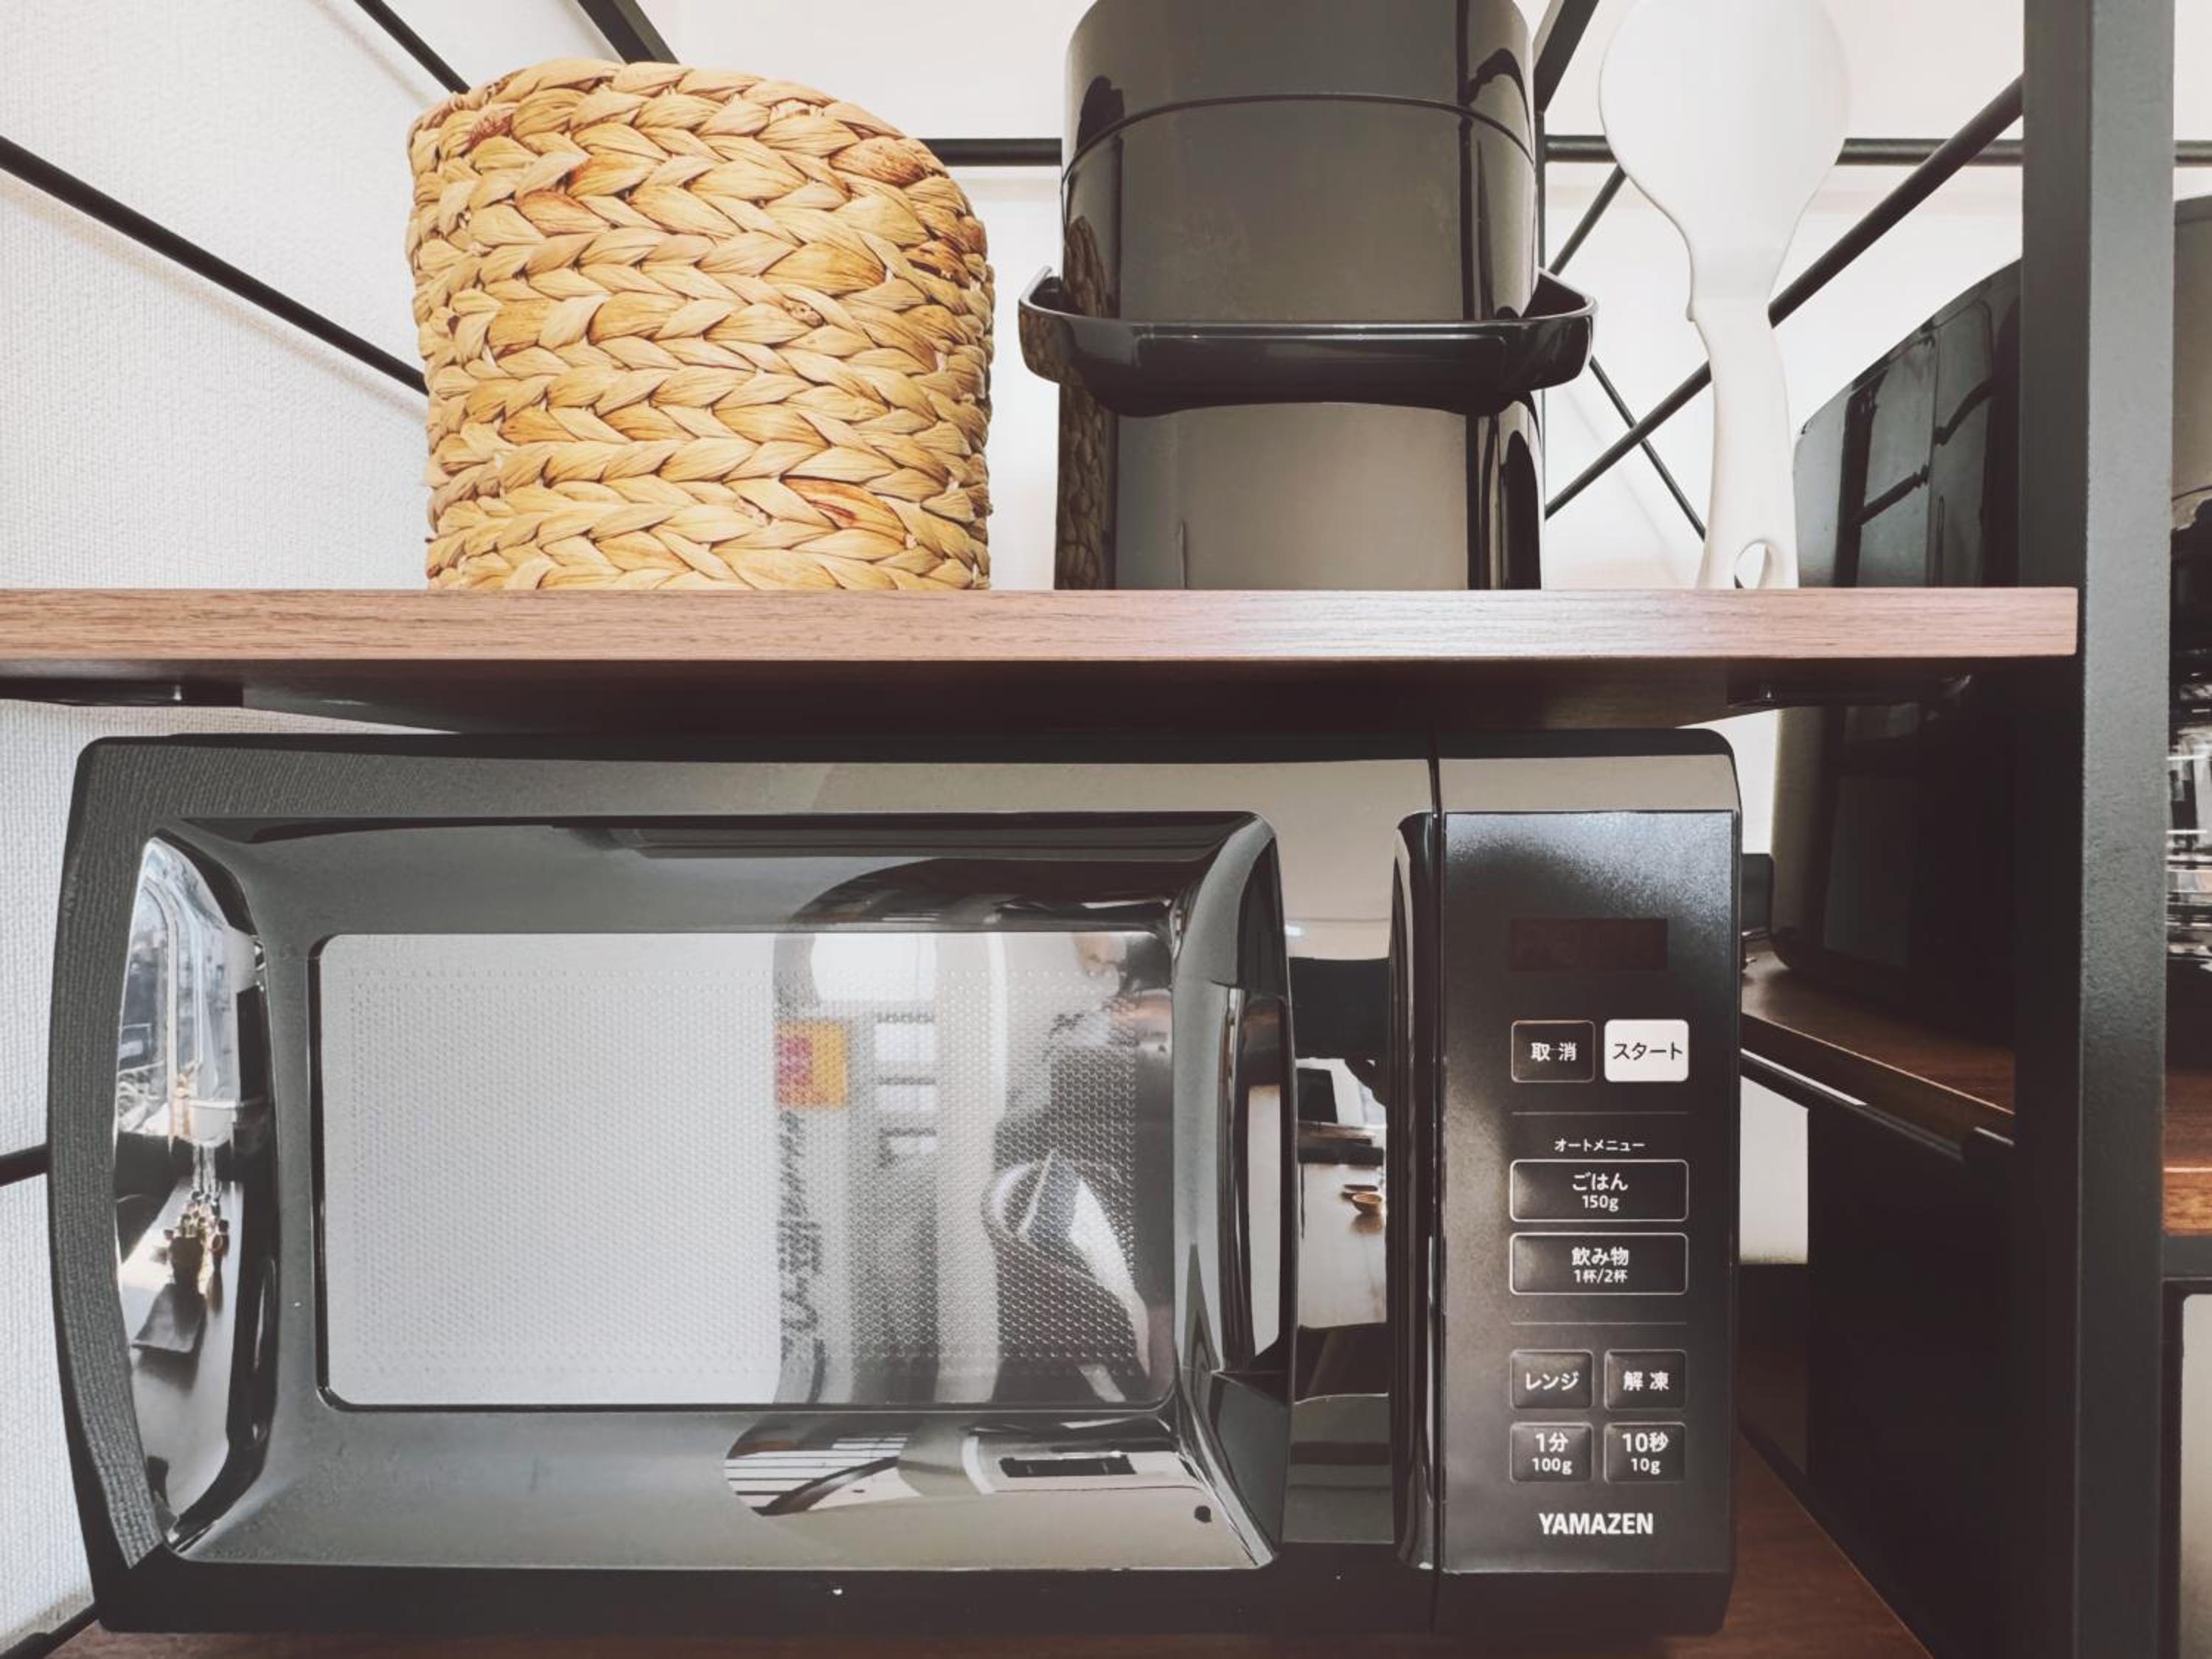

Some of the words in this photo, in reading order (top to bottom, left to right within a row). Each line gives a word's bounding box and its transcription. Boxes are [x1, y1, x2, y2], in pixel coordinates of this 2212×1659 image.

[1613, 1041, 1683, 1061] スタート
[1554, 1138, 1644, 1152] オートメニュー
[1572, 1172, 1629, 1191] ごはん
[1582, 1194, 1618, 1212] 150g
[1571, 1246, 1630, 1266] 飲み物
[1573, 1268, 1627, 1284] 1杯/2杯
[1525, 1371, 1580, 1391] レンジ
[1535, 1432, 1569, 1453] 1分
[1621, 1431, 1669, 1453] 10秒
[1531, 1457, 1573, 1475] 100g
[1630, 1457, 1660, 1475] 10g
[1538, 1512, 1654, 1535] YAMAZEN
